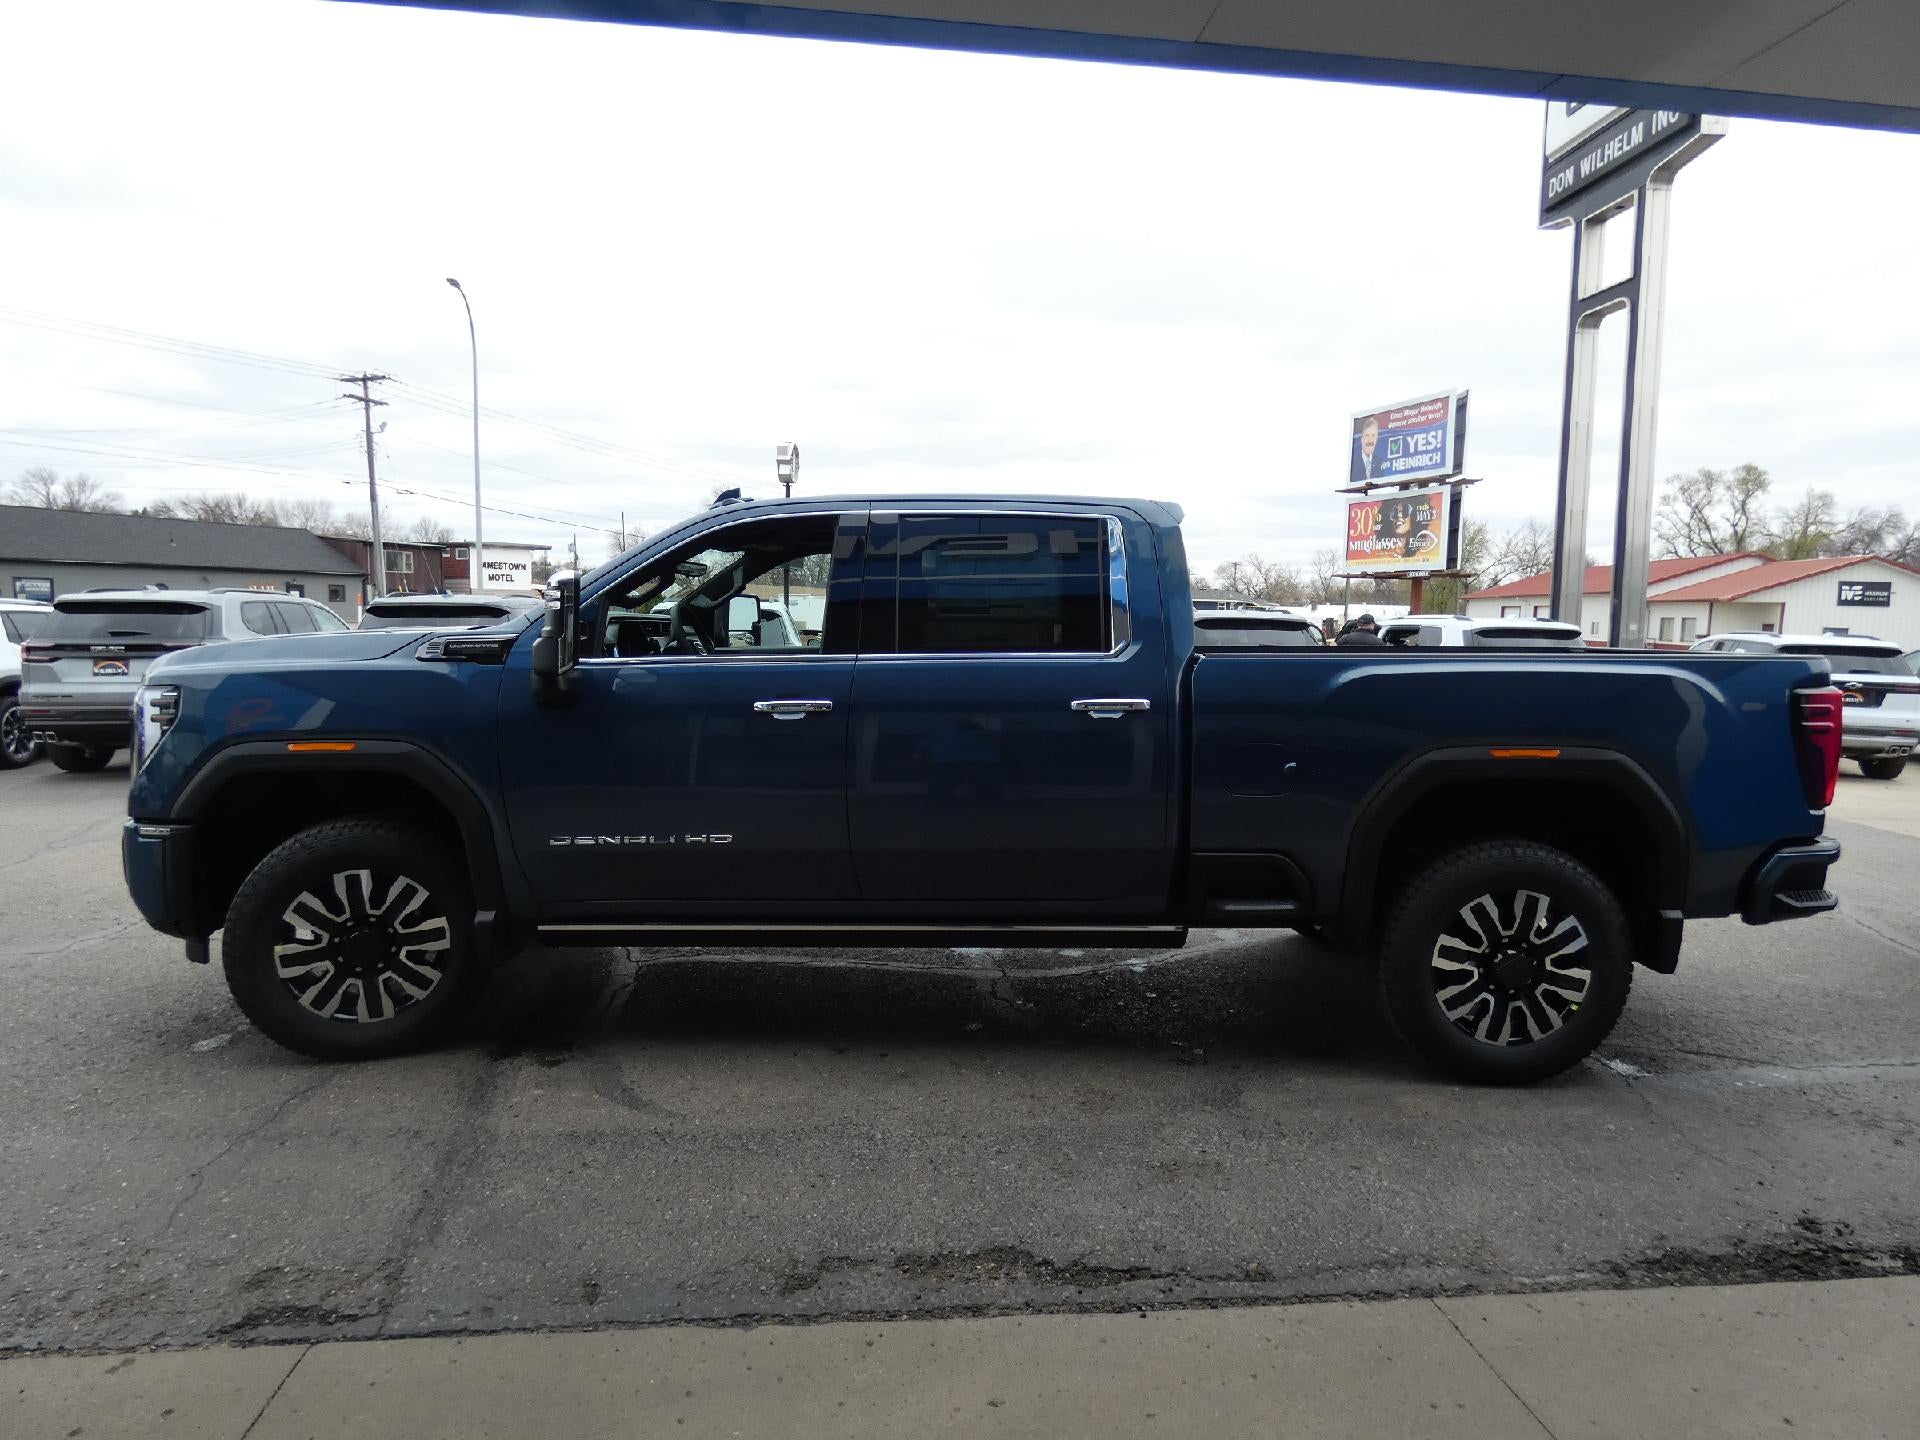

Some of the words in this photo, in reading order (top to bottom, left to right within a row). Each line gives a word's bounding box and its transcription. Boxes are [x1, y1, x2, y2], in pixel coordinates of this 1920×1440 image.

[1549, 166, 1574, 198] DON
[1580, 122, 1644, 179] WILHELM
[1406, 430, 1443, 454] YES!
[1392, 452, 1441, 471] HEINRICH
[1350, 535, 1404, 555] sunglasses
[482, 561, 527, 571] AMESTOWN
[488, 573, 515, 582] MOTEL
[549, 835, 675, 845] DENALI
[684, 834, 733, 844] HD
